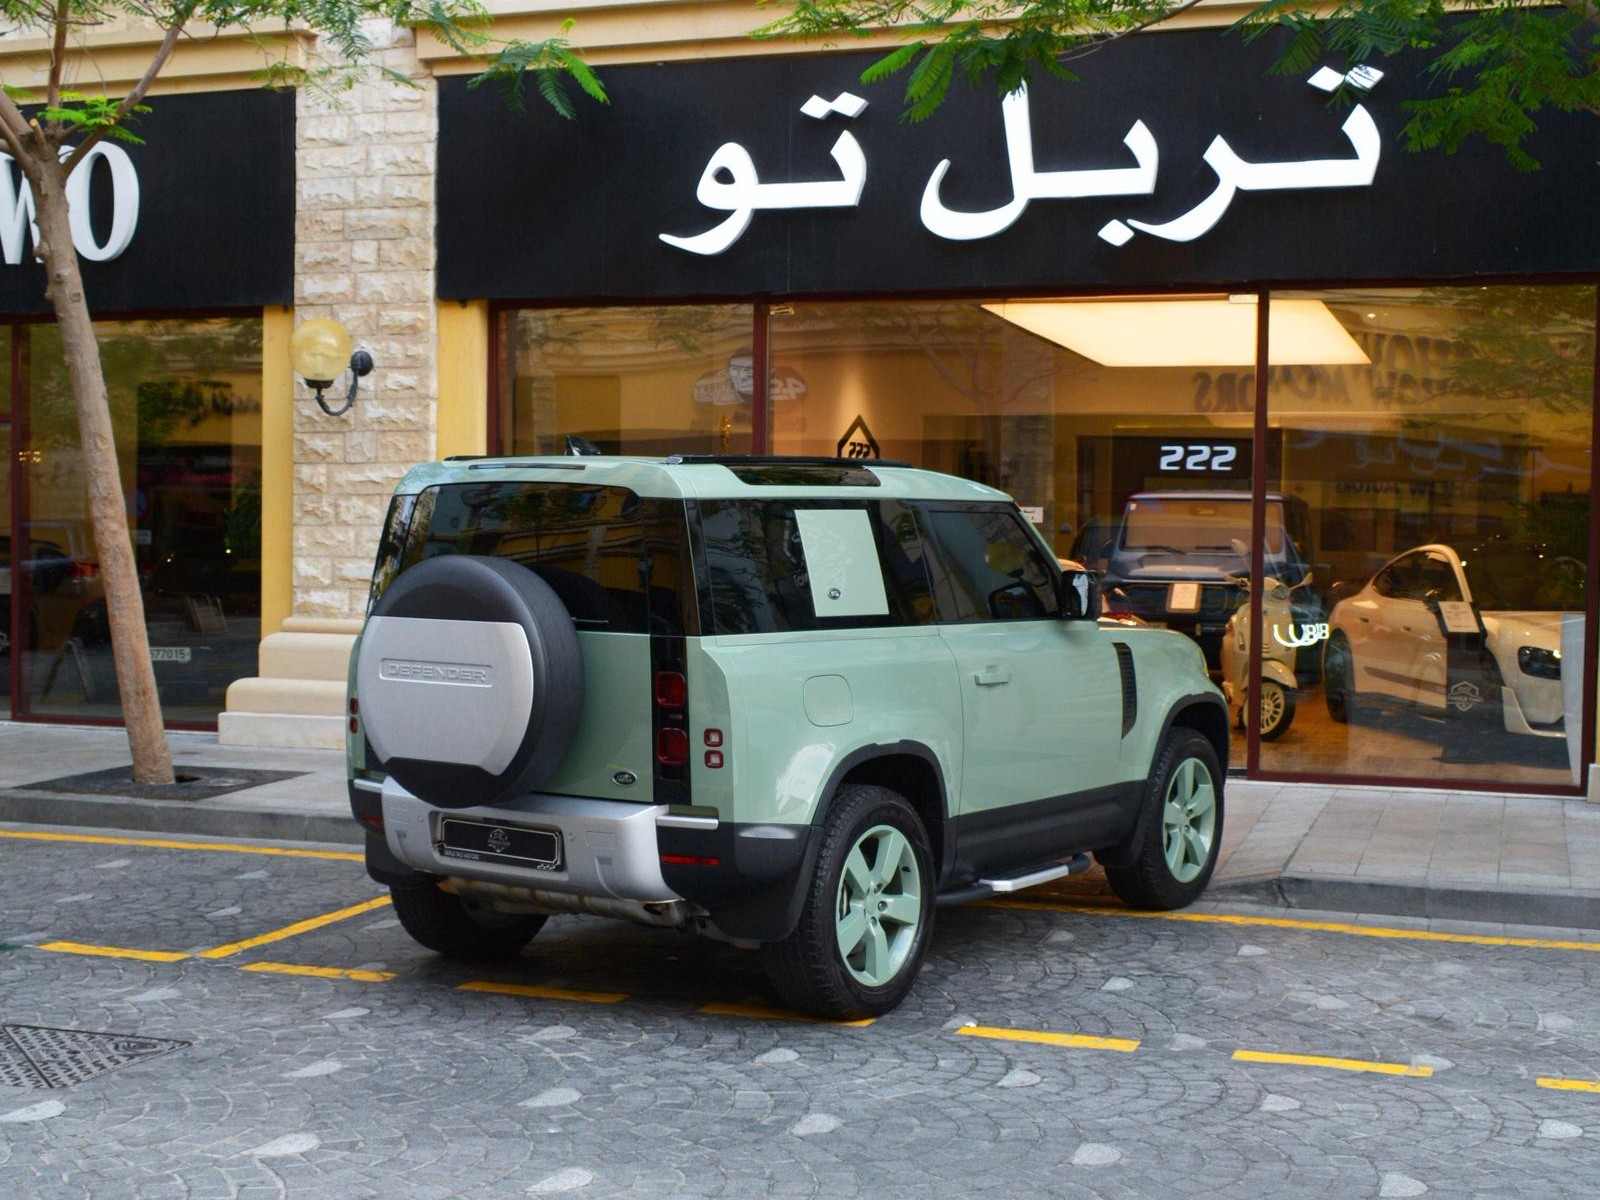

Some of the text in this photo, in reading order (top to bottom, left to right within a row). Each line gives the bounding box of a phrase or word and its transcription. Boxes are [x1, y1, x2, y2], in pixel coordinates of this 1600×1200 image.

[658, 91, 870, 256] تو
[1159, 445, 1238, 471] 222
[387, 662, 487, 683] DEFENDER
